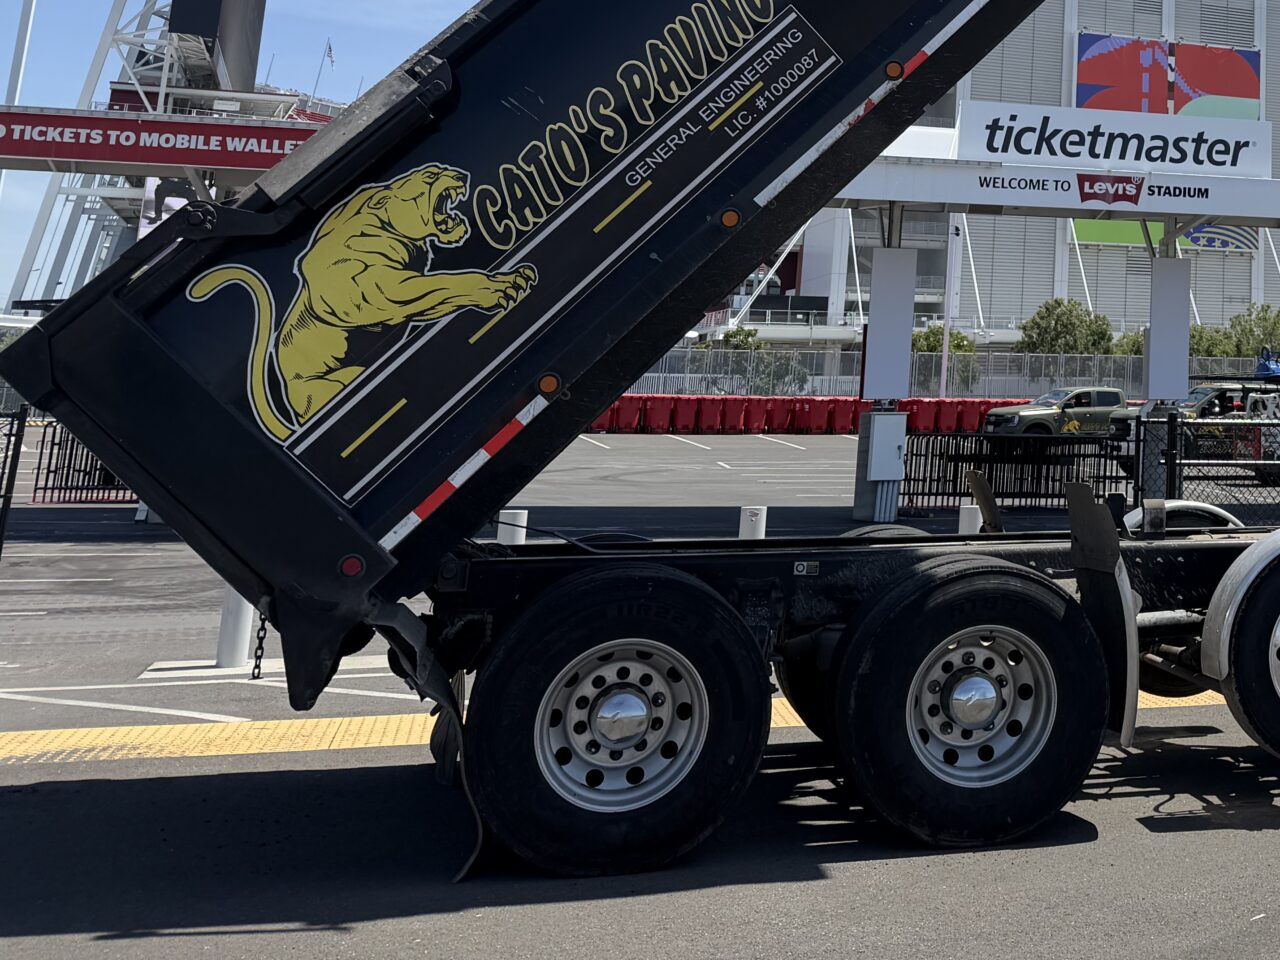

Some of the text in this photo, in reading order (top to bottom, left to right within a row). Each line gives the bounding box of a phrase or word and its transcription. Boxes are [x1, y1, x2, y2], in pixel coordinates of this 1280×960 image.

[625, 28, 803, 187] GENERAL ENGINEERING
[724, 48, 821, 137] LIC. #1000087
[11, 124, 103, 144] TICKETS
[107, 130, 136, 146] TO
[139, 132, 222, 151] MOBILE
[473, 87, 628, 250] CATO'S
[985, 114, 1250, 167] ticketmaster
[979, 176, 1050, 192] WELCOME
[1053, 179, 1071, 192] TO
[1147, 185, 1209, 199] STADIUM
